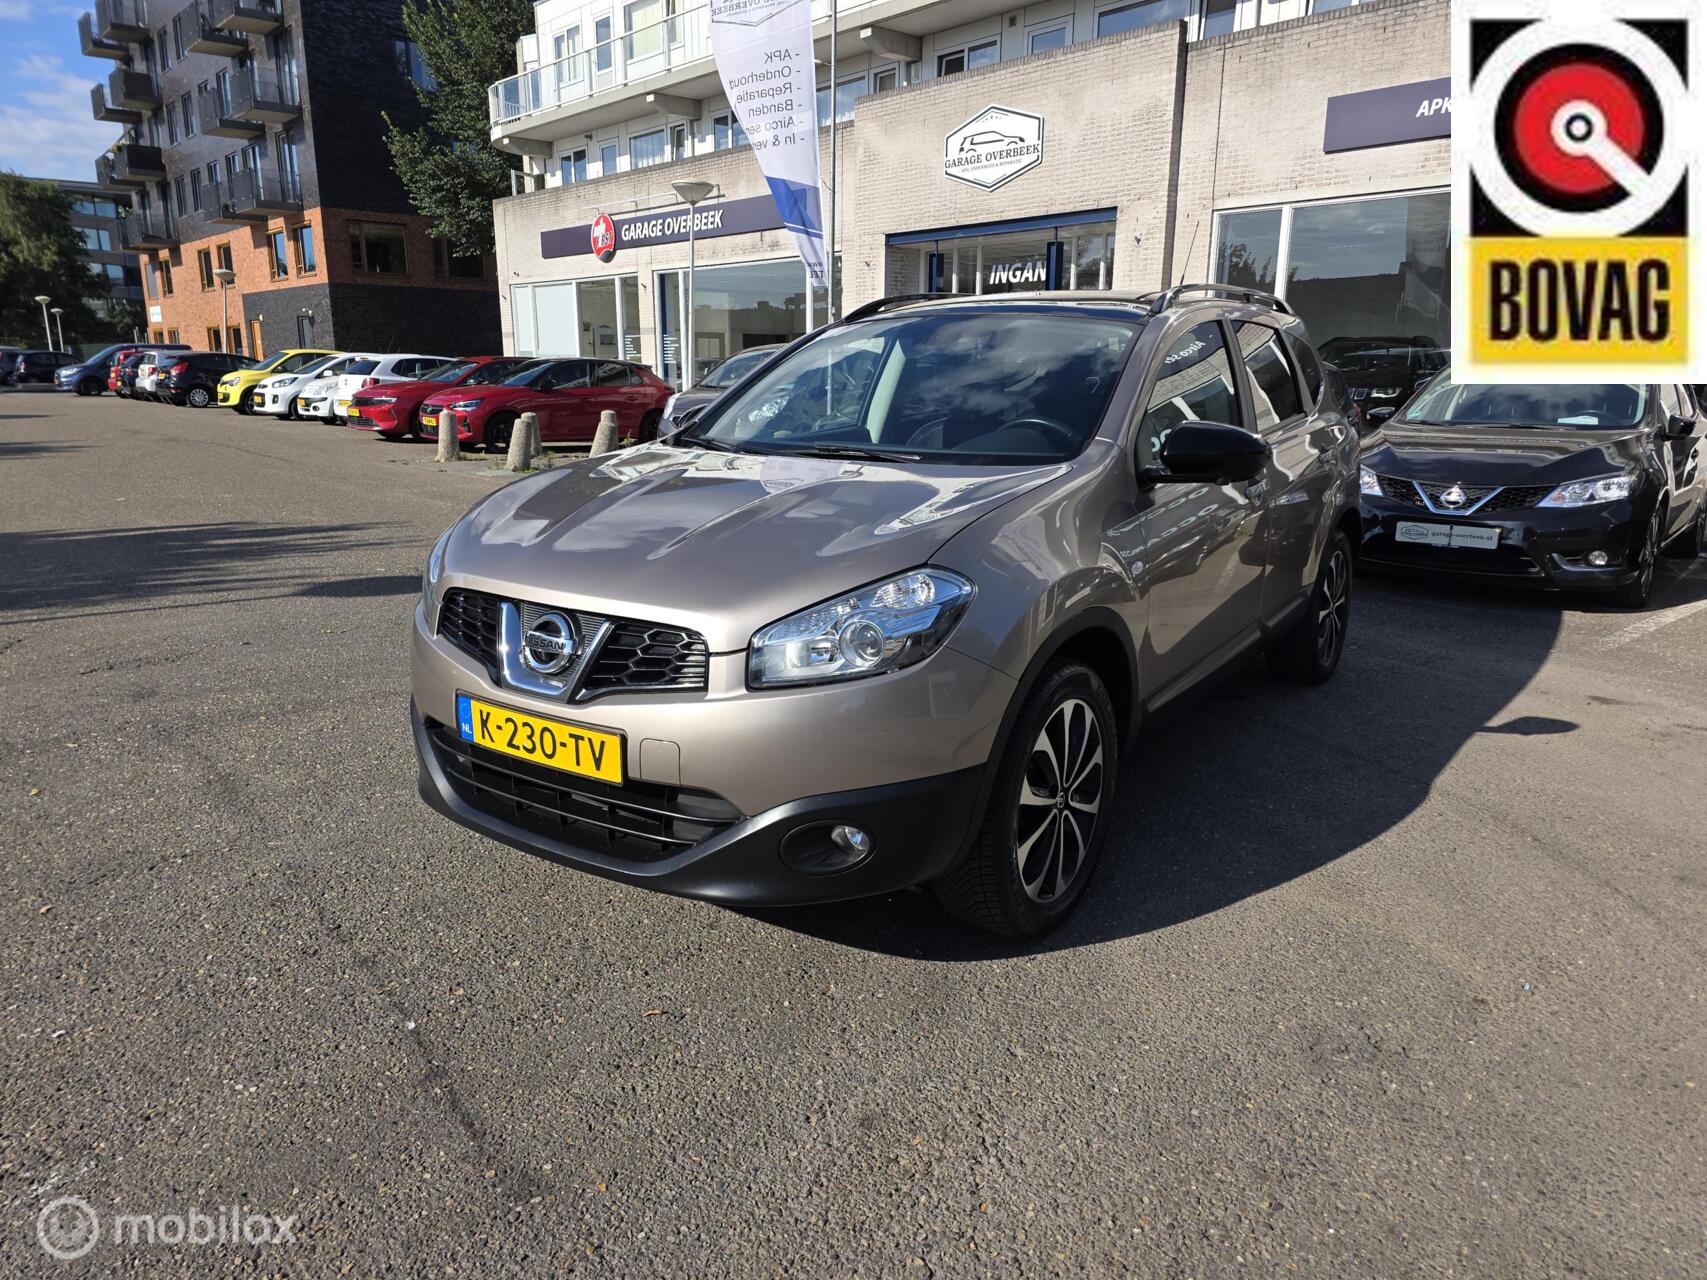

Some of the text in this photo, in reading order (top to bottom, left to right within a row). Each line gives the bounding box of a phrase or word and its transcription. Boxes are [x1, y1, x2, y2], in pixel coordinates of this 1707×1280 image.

[945, 143, 1041, 169] GARAGE OVERBEEK
[621, 218, 663, 241] GARAGE
[664, 209, 724, 236] OVERBEEK
[528, 633, 566, 650] NISSAN
[462, 709, 606, 771] NL K-230-TV
